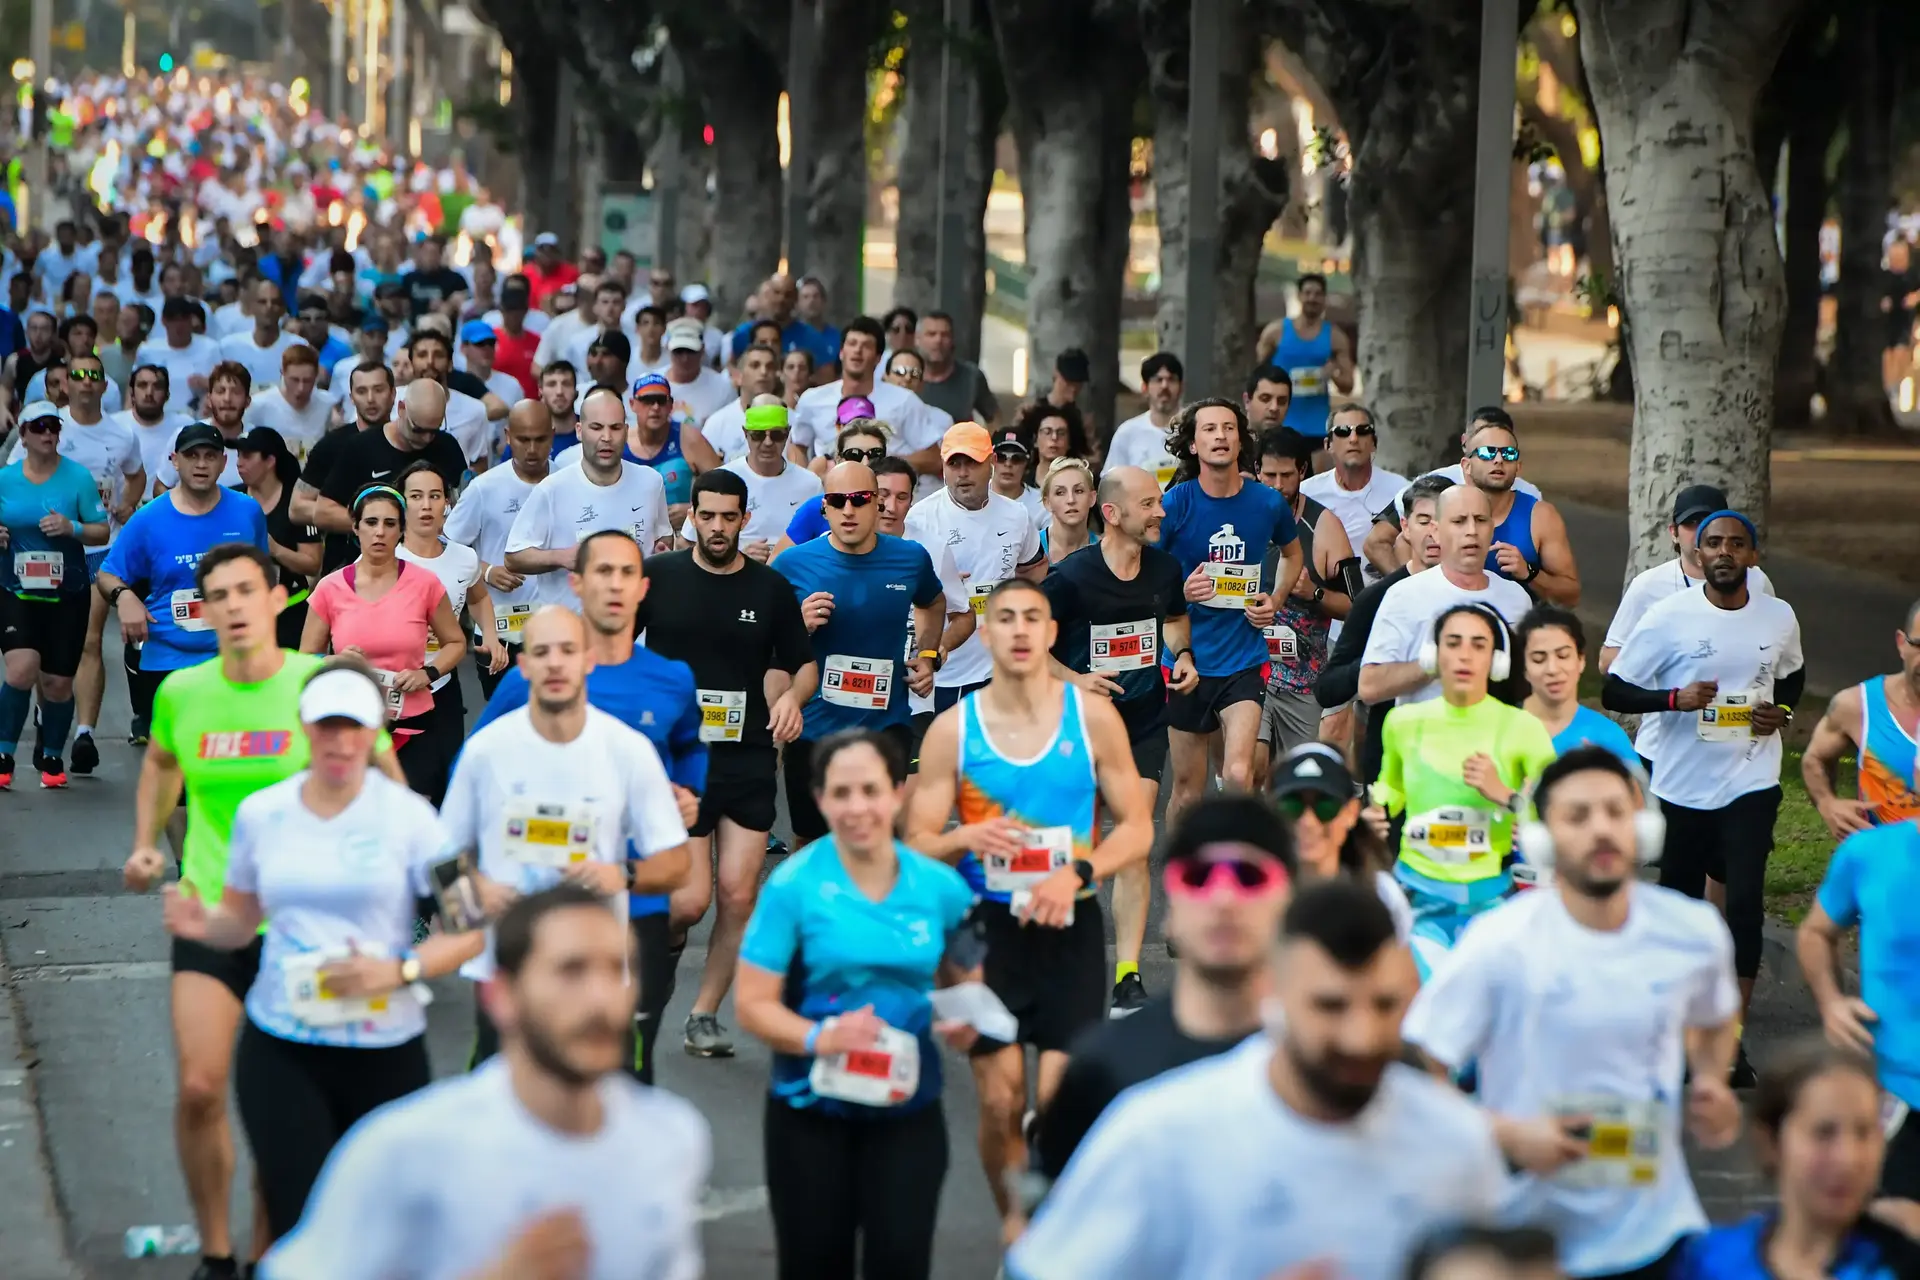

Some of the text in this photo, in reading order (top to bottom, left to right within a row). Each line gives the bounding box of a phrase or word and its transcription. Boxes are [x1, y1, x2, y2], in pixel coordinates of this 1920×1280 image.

[1224, 581, 1246, 592] 10824
[1119, 640, 1138, 652] 5747
[851, 677, 872, 689] 8211
